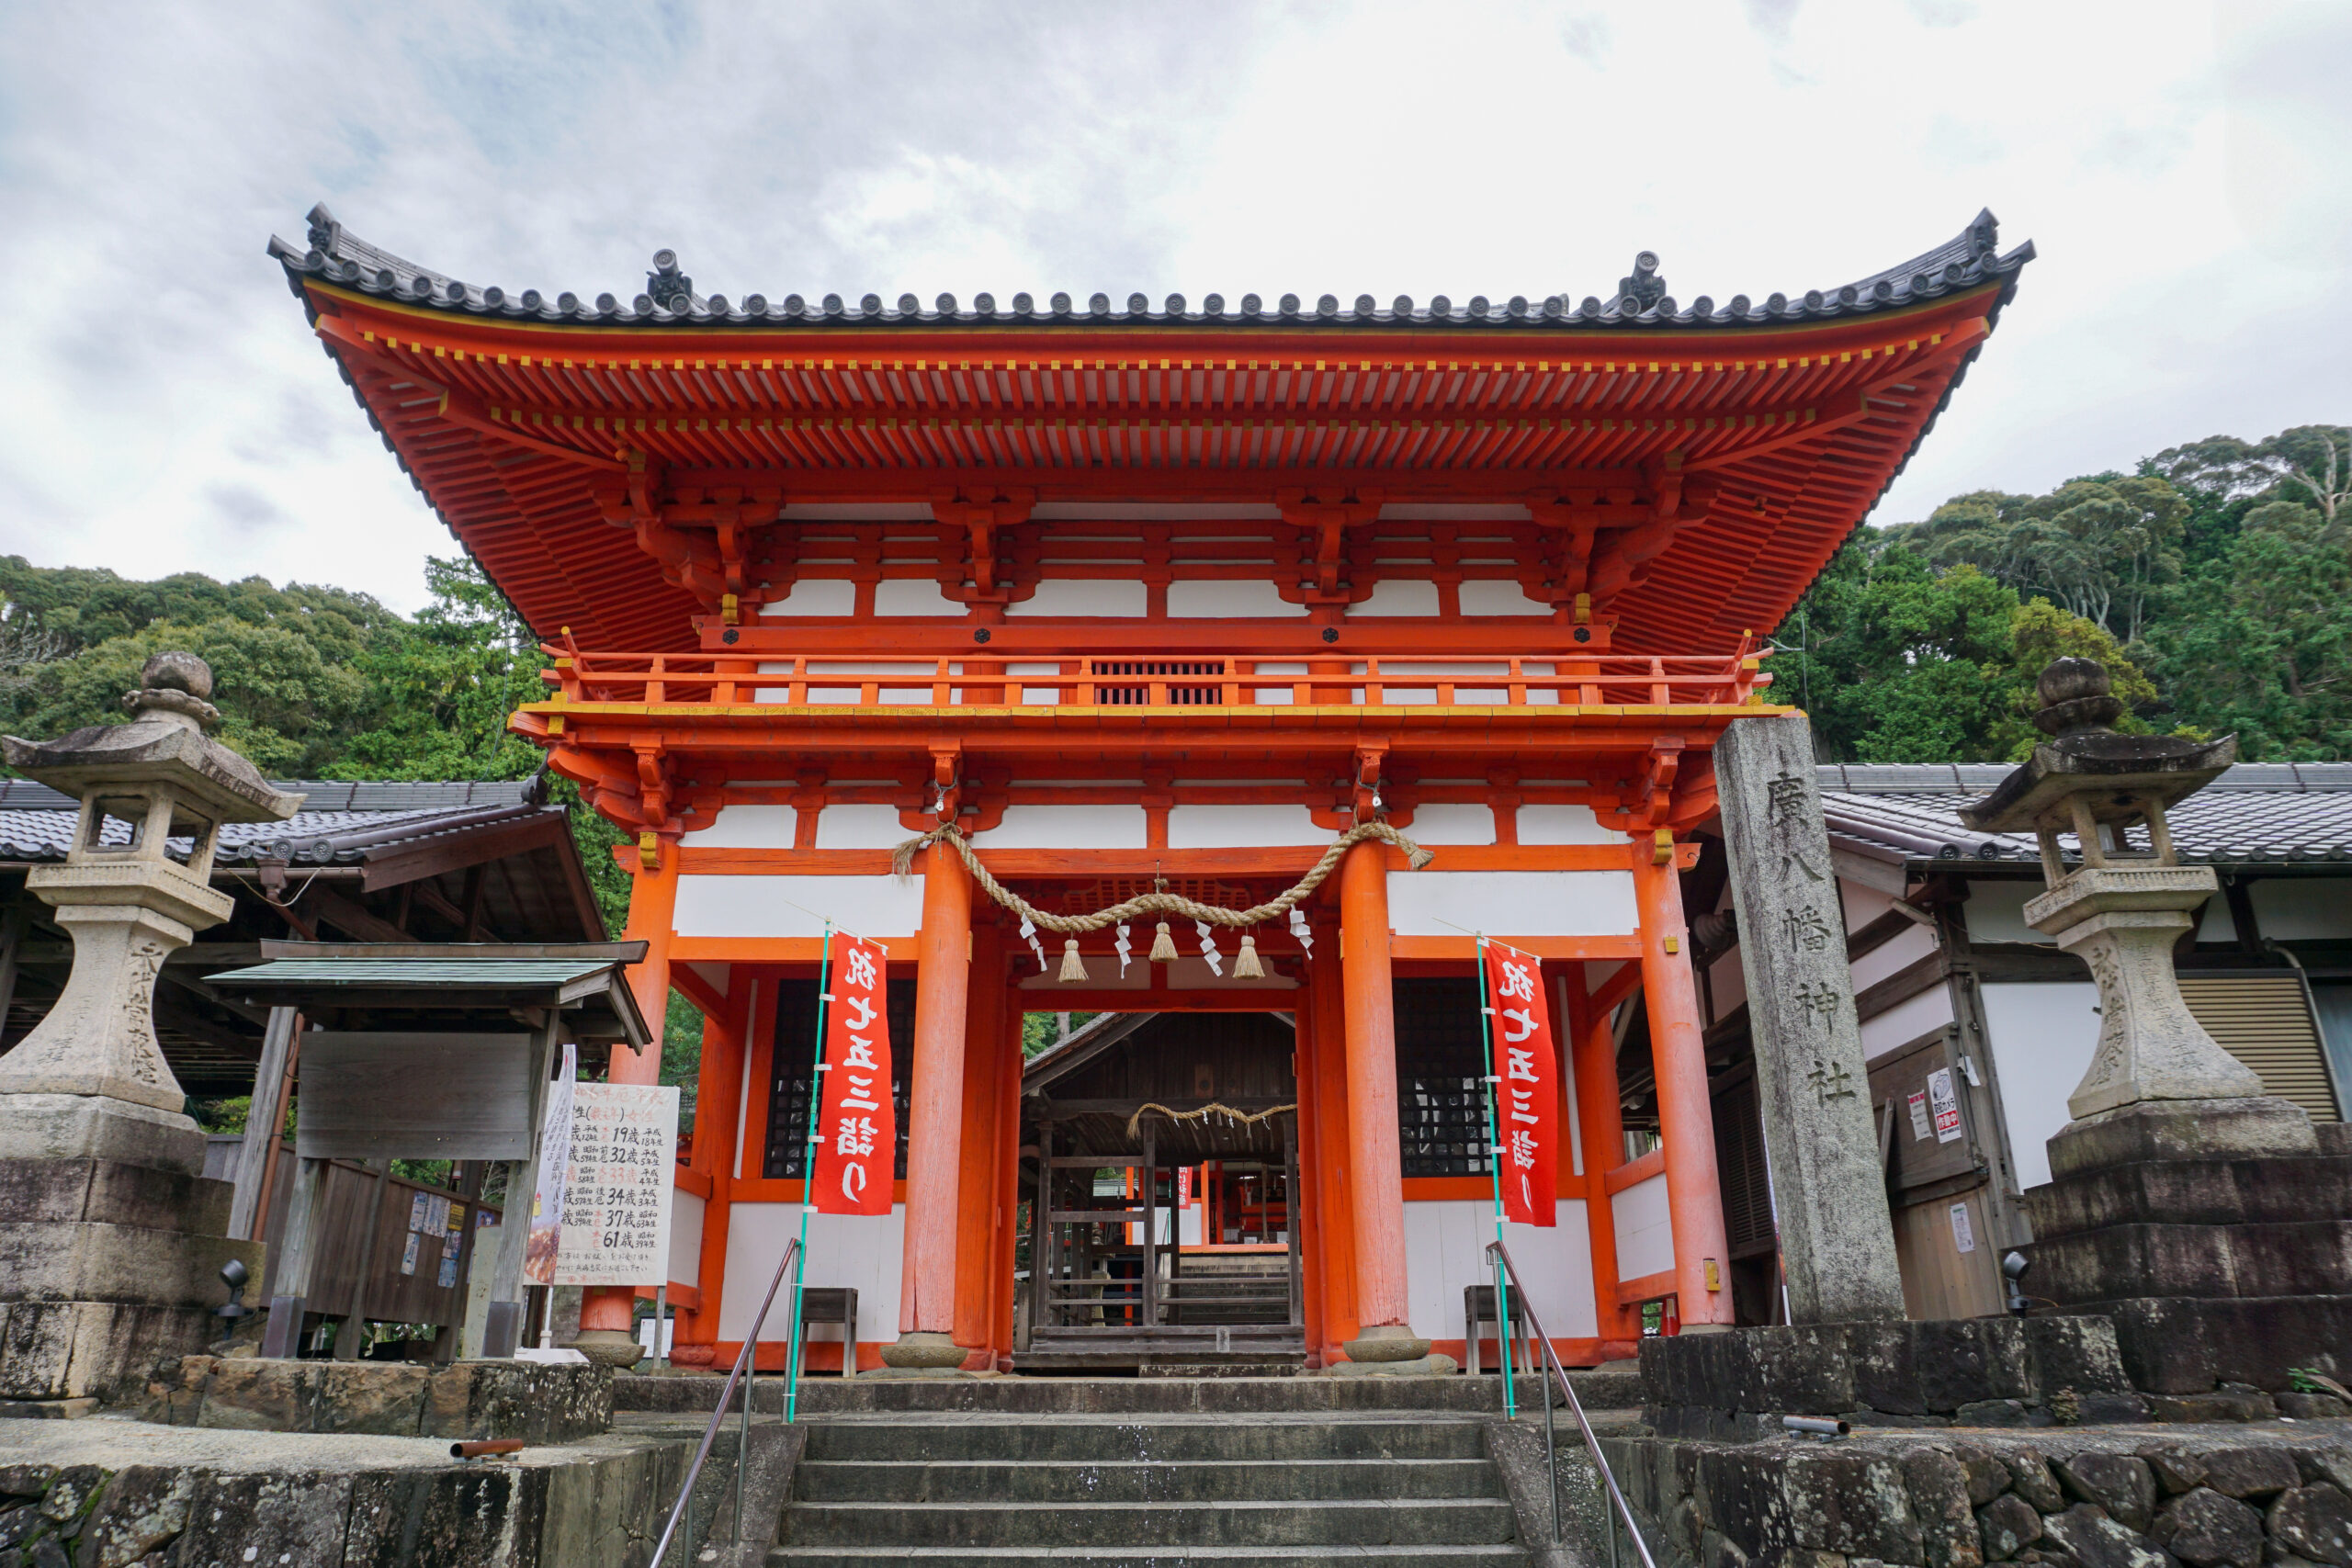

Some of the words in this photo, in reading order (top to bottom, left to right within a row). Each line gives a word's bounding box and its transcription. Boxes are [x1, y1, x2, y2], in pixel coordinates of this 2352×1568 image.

[1765, 770, 1857, 1110] 廣八幡神社
[1938, 1112, 1958, 1129] 作動中
[613, 1127, 639, 1145] 19歳
[644, 1128, 661, 1136] 平成
[641, 1138, 663, 1146] 18年生
[610, 1146, 638, 1165] 32歳
[641, 1149, 659, 1157] 平成
[610, 1167, 638, 1185] 33歳
[641, 1168, 658, 1177] 平成
[639, 1178, 660, 1186] 4年生
[563, 1187, 573, 1205] 歳
[606, 1188, 636, 1206] 34歳
[640, 1190, 657, 1198] 平成
[638, 1199, 658, 1207] 3年生
[561, 1209, 573, 1226] 歳
[605, 1210, 636, 1228] 37歳
[636, 1220, 657, 1228] 63年生
[604, 1231, 634, 1248] 61歳
[635, 1240, 656, 1248] 39年生
